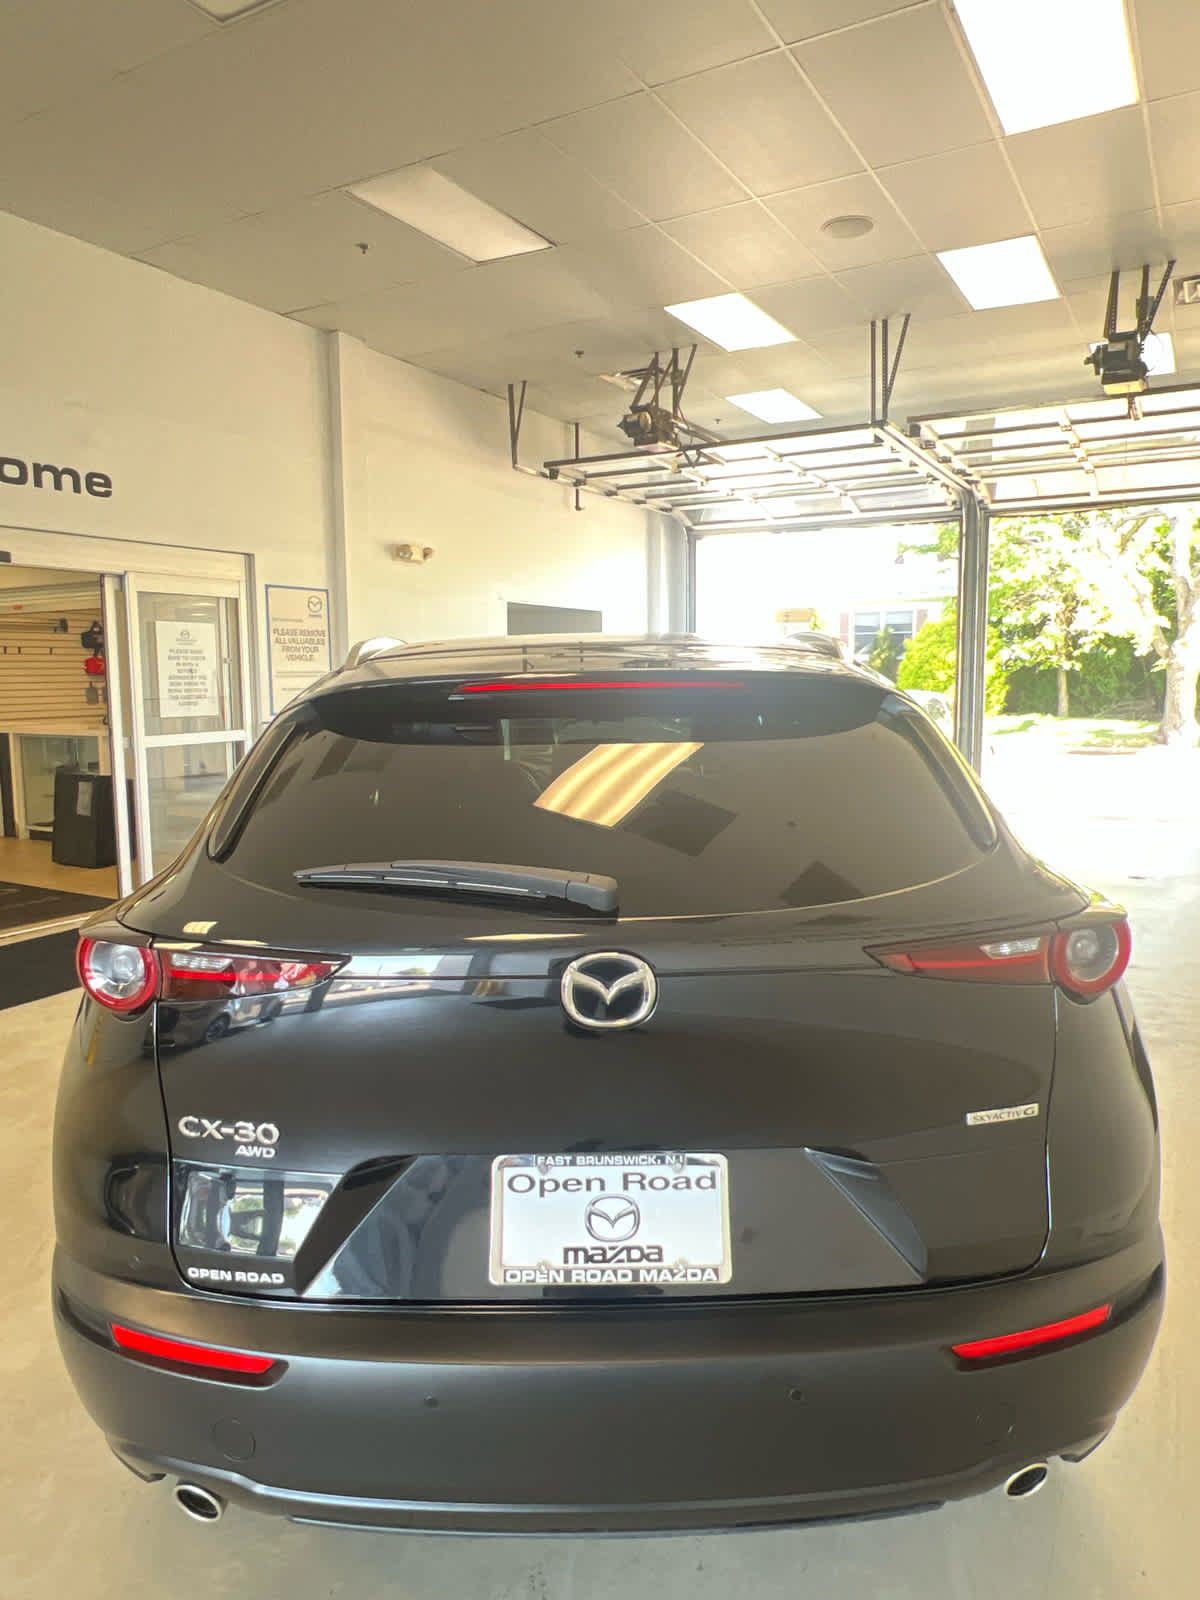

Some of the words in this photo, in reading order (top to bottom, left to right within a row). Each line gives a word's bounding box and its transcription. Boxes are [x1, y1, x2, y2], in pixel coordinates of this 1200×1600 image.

[0, 457, 112, 498] ome
[273, 628, 297, 636] PLEASE
[299, 629, 326, 637] REMOVE
[178, 1115, 280, 1145] CX-30
[235, 1145, 276, 1158] AWD
[507, 1173, 606, 1198] Open
[622, 1171, 717, 1192] Road
[187, 1267, 233, 1282] OPEN
[235, 1271, 285, 1284] ROAD
[505, 1268, 564, 1283] OPEN
[571, 1268, 633, 1283] ROAD
[640, 1267, 718, 1282] MAZDA
